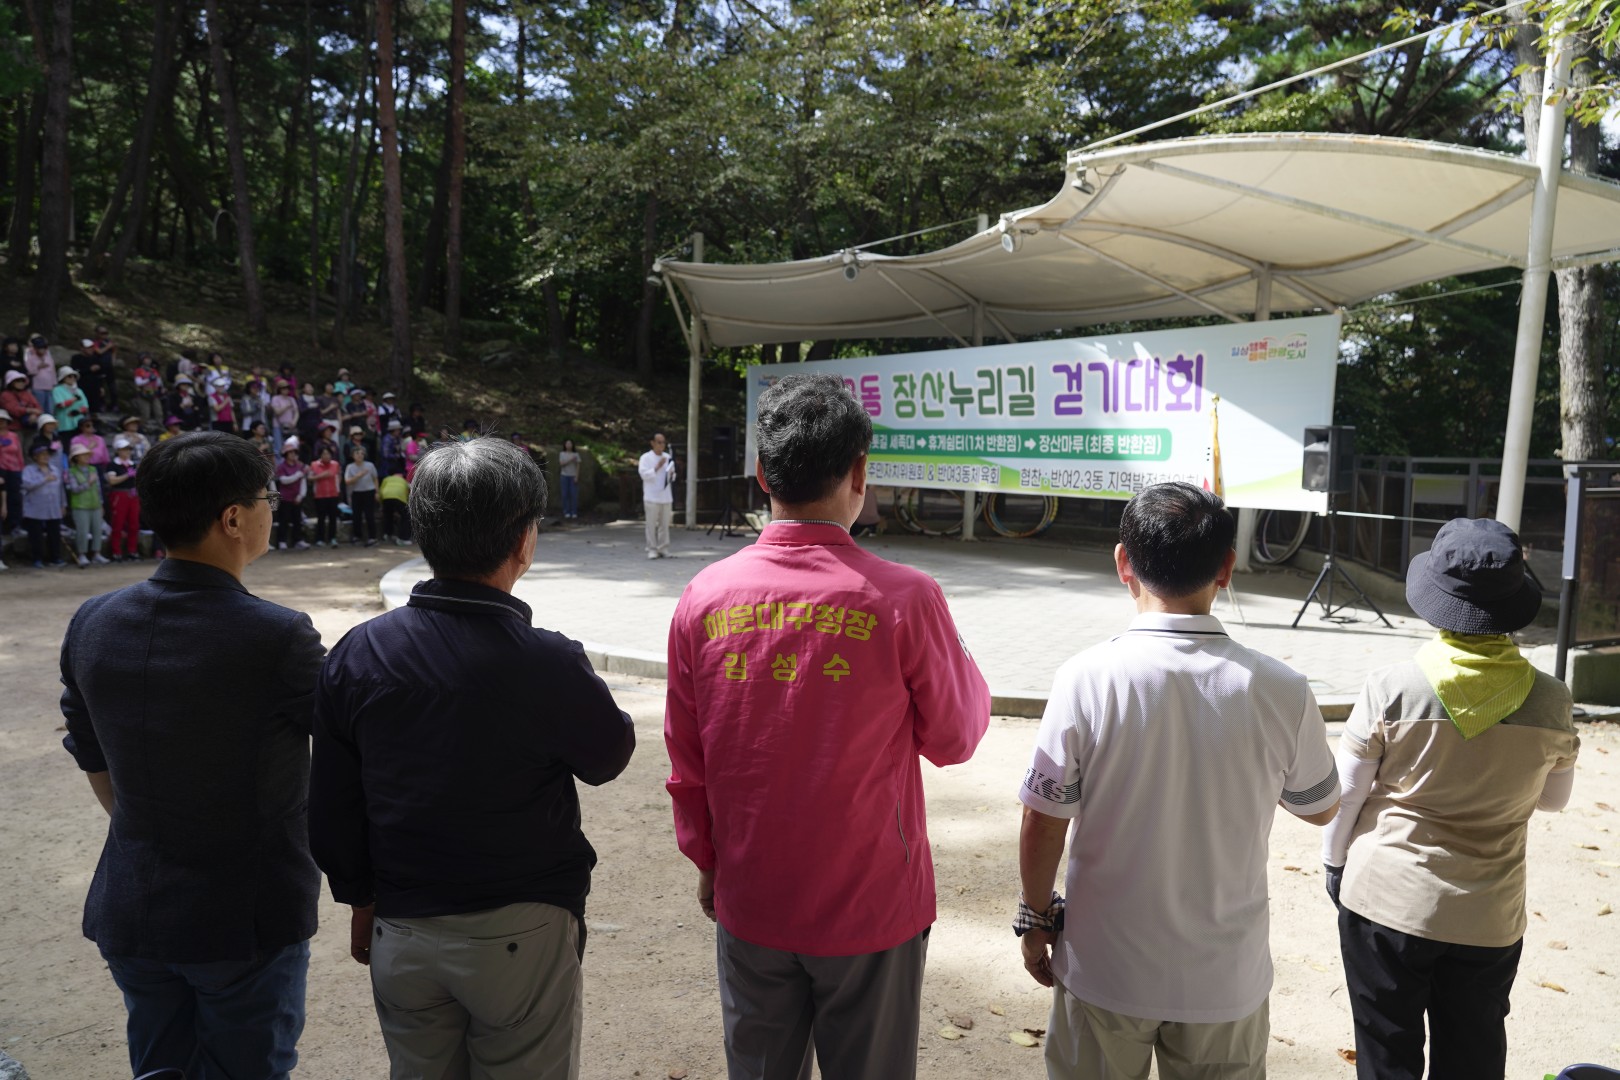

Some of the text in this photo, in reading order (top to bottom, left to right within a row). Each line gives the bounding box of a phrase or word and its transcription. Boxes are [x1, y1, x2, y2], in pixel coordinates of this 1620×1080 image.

[892, 365, 1036, 419] 장산누리길
[1052, 353, 1204, 416] 걷기대회
[928, 433, 985, 453] 휴게쉼터(1차
[986, 434, 1022, 453] 반환점)
[1039, 434, 1114, 455] 장산마루(최종
[1117, 433, 1162, 455] 반환점)
[868, 462, 925, 481] 주민자치위원회
[928, 465, 935, 481] &
[937, 465, 1000, 485] 반여3동체육회
[702, 601, 878, 641] 해운대구청장
